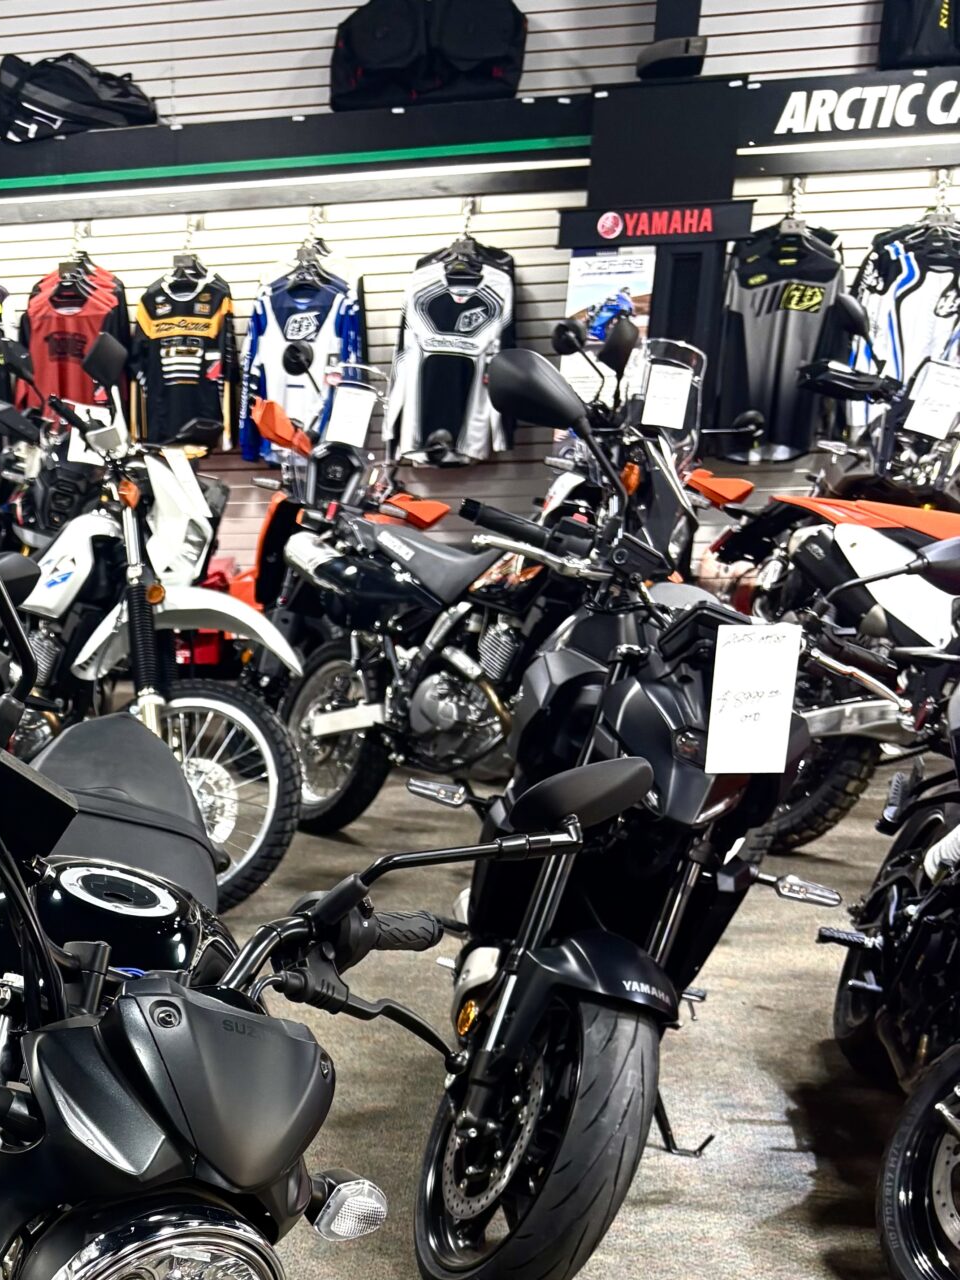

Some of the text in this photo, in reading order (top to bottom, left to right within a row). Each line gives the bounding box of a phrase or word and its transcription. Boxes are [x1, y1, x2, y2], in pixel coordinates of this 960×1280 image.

[774, 82, 926, 134] ARCTIC
[624, 208, 713, 236] YAMAHA
[622, 980, 672, 1007] YAMAHA
